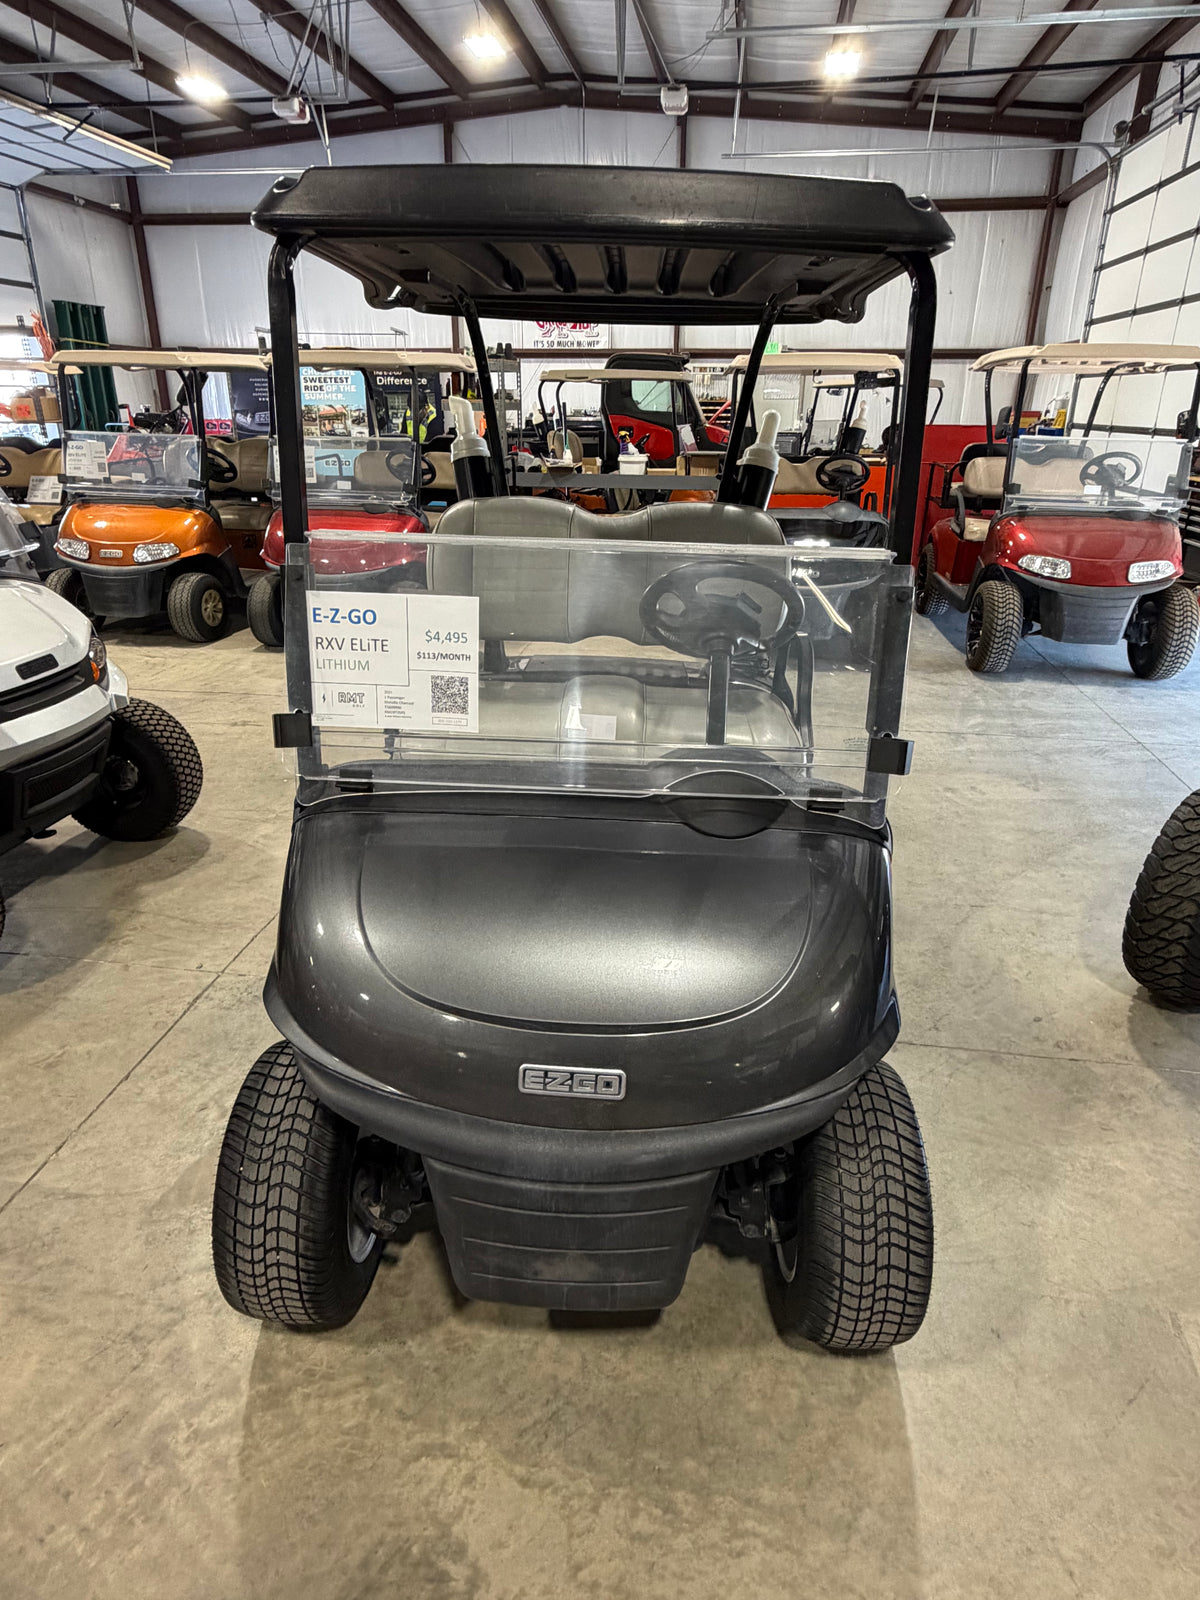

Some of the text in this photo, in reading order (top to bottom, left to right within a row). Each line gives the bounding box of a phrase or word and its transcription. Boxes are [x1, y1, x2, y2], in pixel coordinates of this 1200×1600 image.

[533, 340, 545, 348] IT'S
[546, 340, 555, 348] SO
[556, 340, 575, 348] MUCH
[303, 376, 349, 384] SWEETEST
[312, 607, 377, 625] E-Z-GO
[425, 629, 468, 645] $4,495
[315, 636, 389, 653] RXV ELiTE
[416, 651, 471, 662] $113/MONTH
[316, 658, 370, 671] LITHIUM
[337, 691, 365, 704] RMT
[523, 1068, 621, 1096] EZGO
